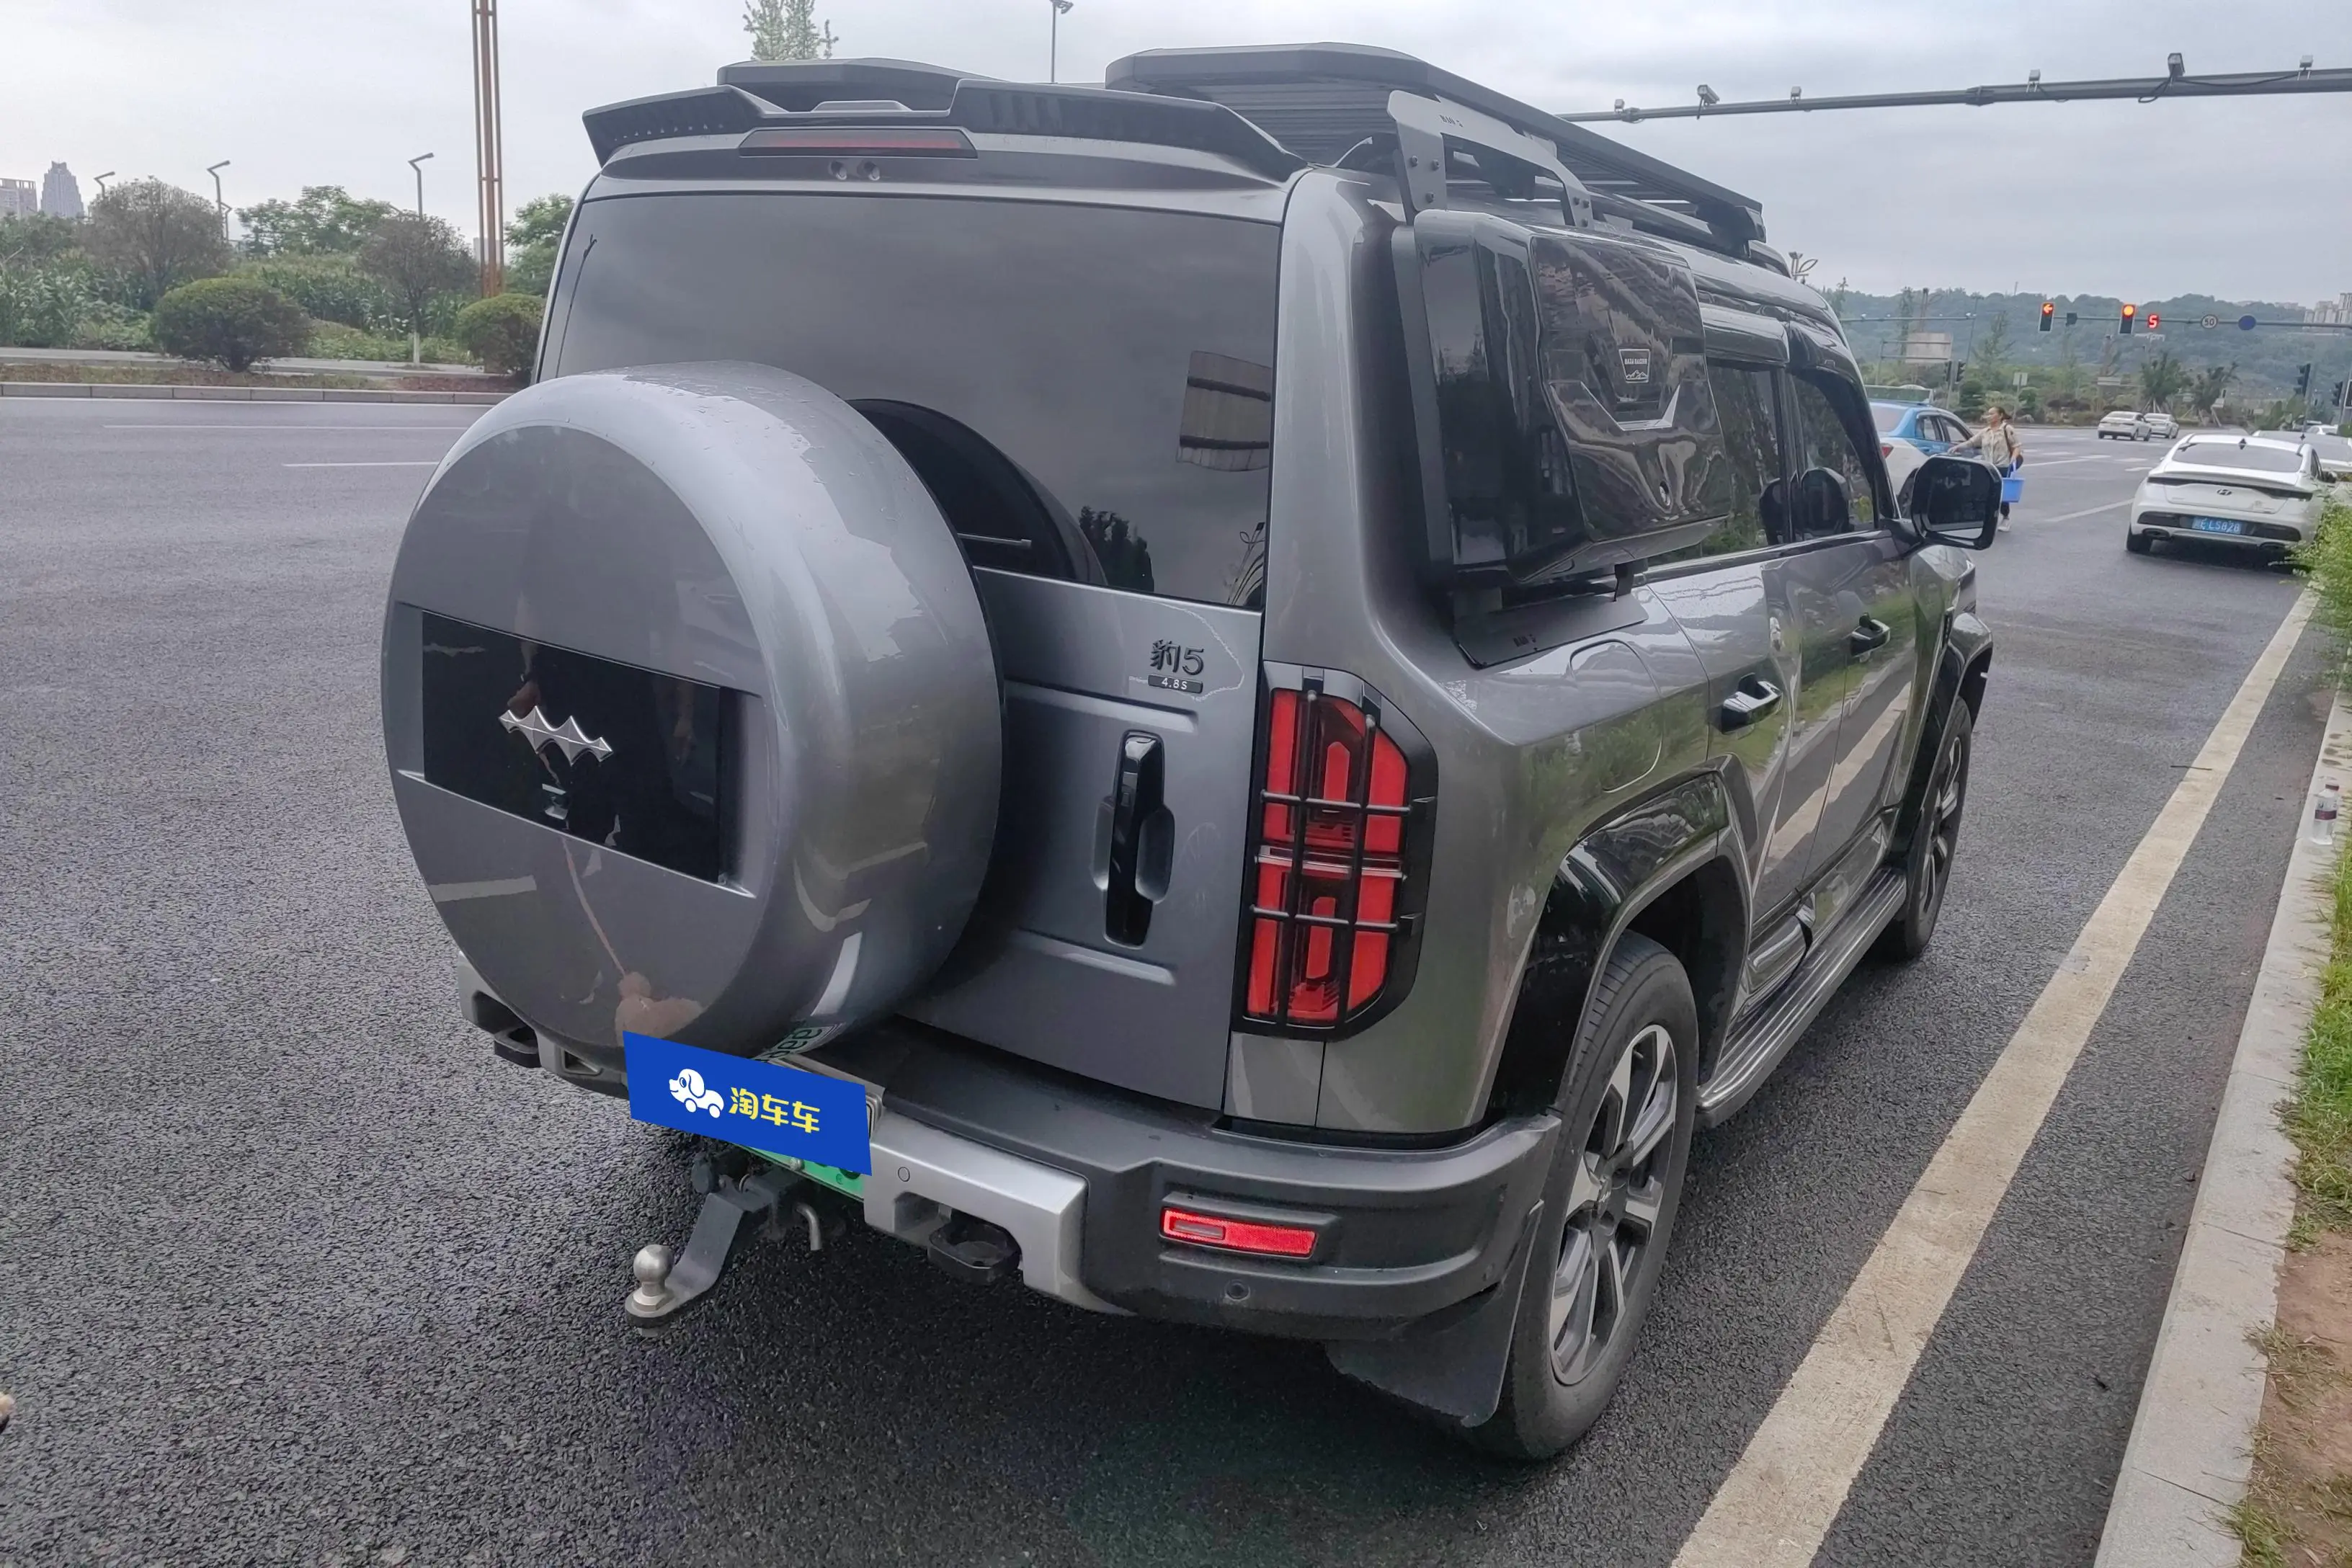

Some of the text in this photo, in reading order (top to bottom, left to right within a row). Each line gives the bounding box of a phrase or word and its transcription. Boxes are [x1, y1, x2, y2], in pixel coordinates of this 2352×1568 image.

[2148, 315, 2158, 329] 5
[1150, 639, 1205, 676] 豹5
[1161, 677, 1188, 690] 4.8S
